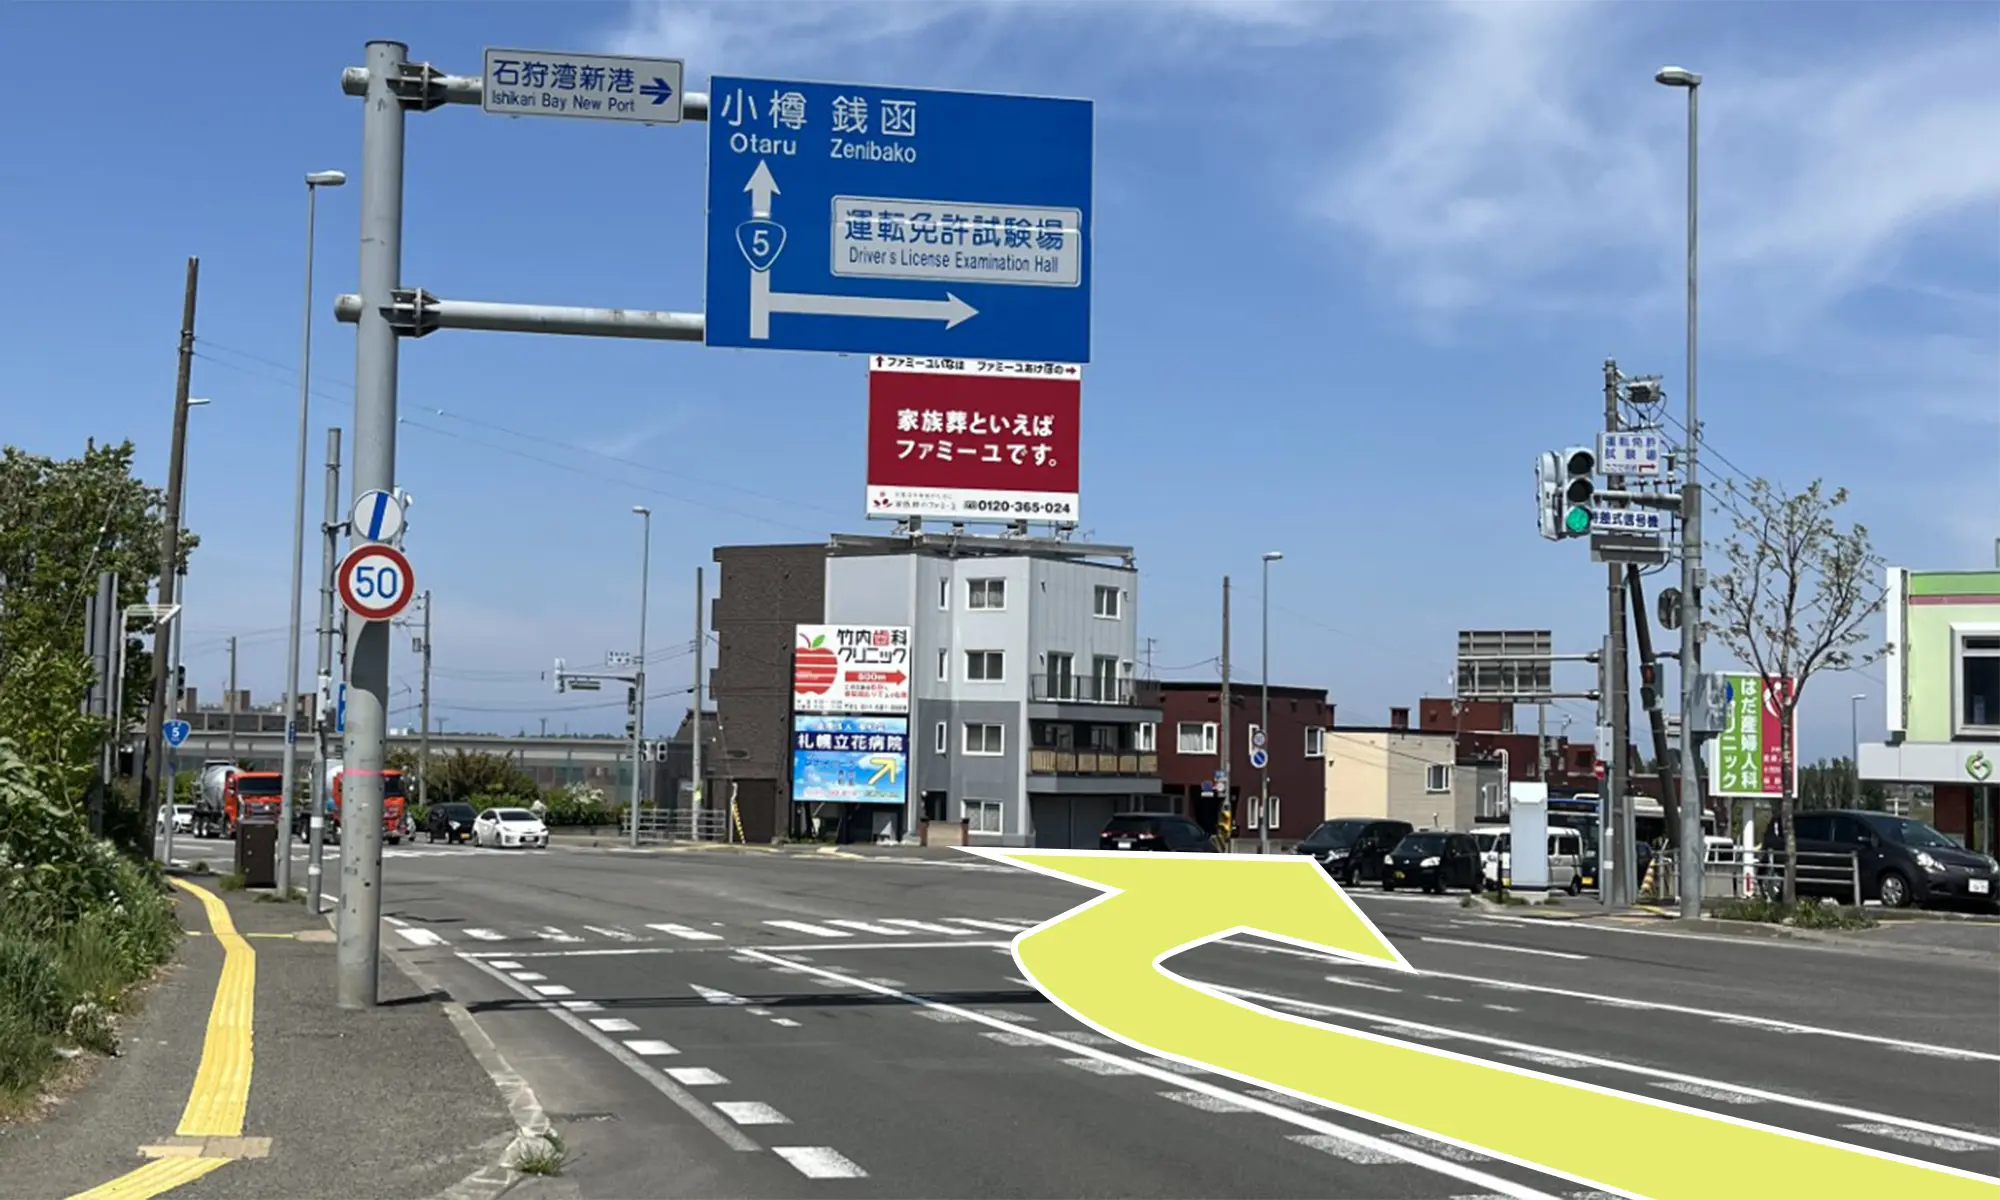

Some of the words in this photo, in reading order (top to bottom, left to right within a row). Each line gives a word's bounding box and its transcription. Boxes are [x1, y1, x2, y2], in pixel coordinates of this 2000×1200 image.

[492, 59, 635, 94] 石狩湾新港
[491, 90, 537, 107] Ishikari
[541, 92, 568, 112] Bay
[572, 96, 601, 111] New
[607, 98, 636, 113] Port
[721, 88, 808, 131] 小樽
[831, 95, 917, 137] 銭函
[729, 132, 797, 156] Otaru
[829, 138, 917, 164] Zenibako
[752, 230, 770, 257] 5
[844, 209, 1065, 251] 運転免許試験場
[900, 248, 950, 268] License
[954, 251, 1031, 273] Examination
[1033, 256, 1059, 274] Hall
[896, 408, 1056, 438] 家族葬といえば
[896, 440, 1058, 468] ファミーユです。
[1605, 436, 1656, 448] 運転免許
[356, 566, 398, 599] 50
[837, 628, 908, 647] 竹内歯科
[837, 647, 907, 664] クリニック
[172, 727, 180, 737] 5
[797, 732, 903, 751] 札幌立花病院
[1740, 678, 1758, 789] はだ産婦人科
